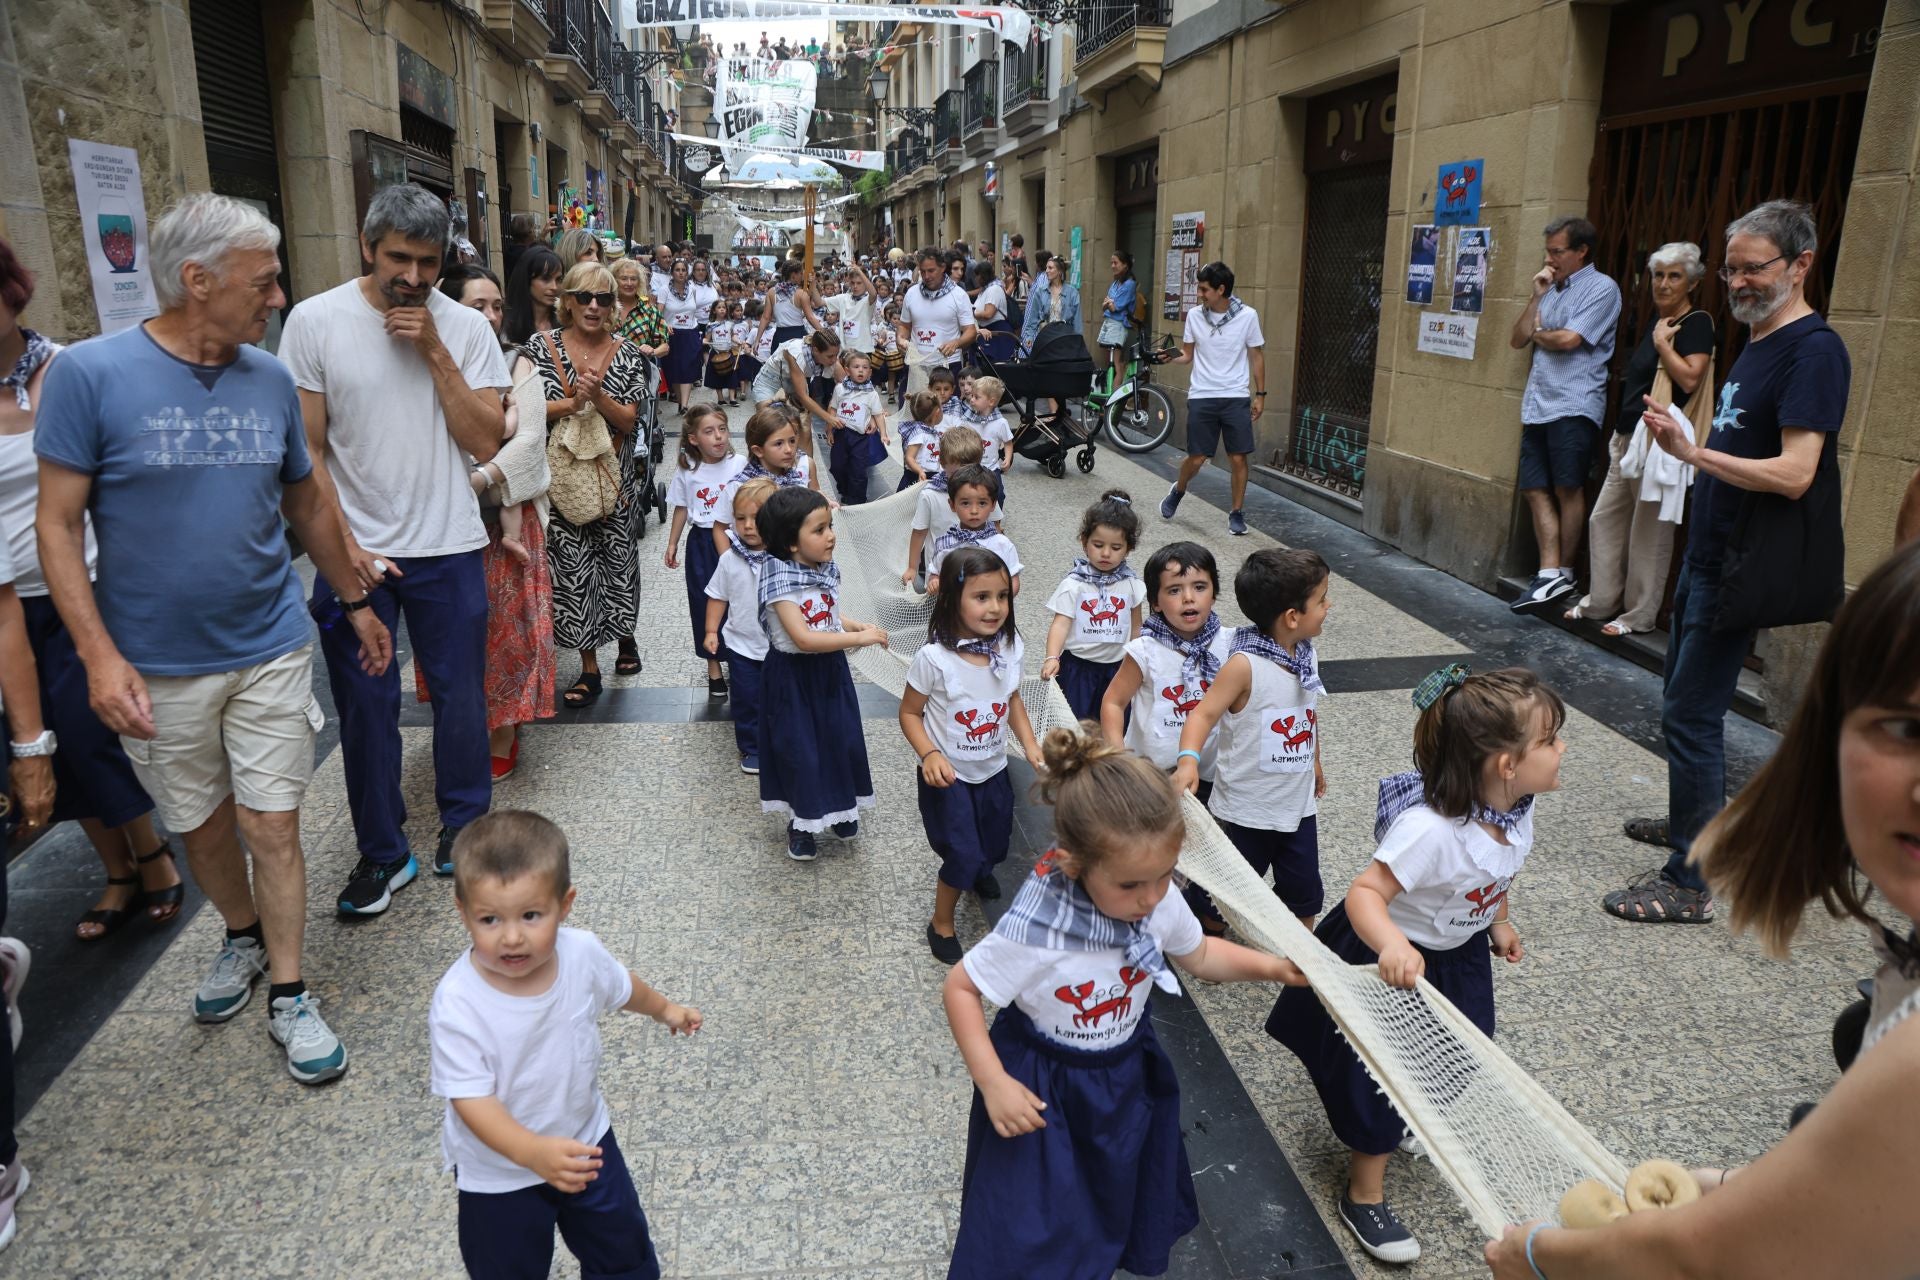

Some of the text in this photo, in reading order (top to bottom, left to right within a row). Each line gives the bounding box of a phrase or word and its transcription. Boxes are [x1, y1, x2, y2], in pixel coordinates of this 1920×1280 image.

[1163, 718, 1185, 727] karm
[1272, 753, 1309, 763] karmengo
[1055, 1025, 1116, 1041] karmengo
